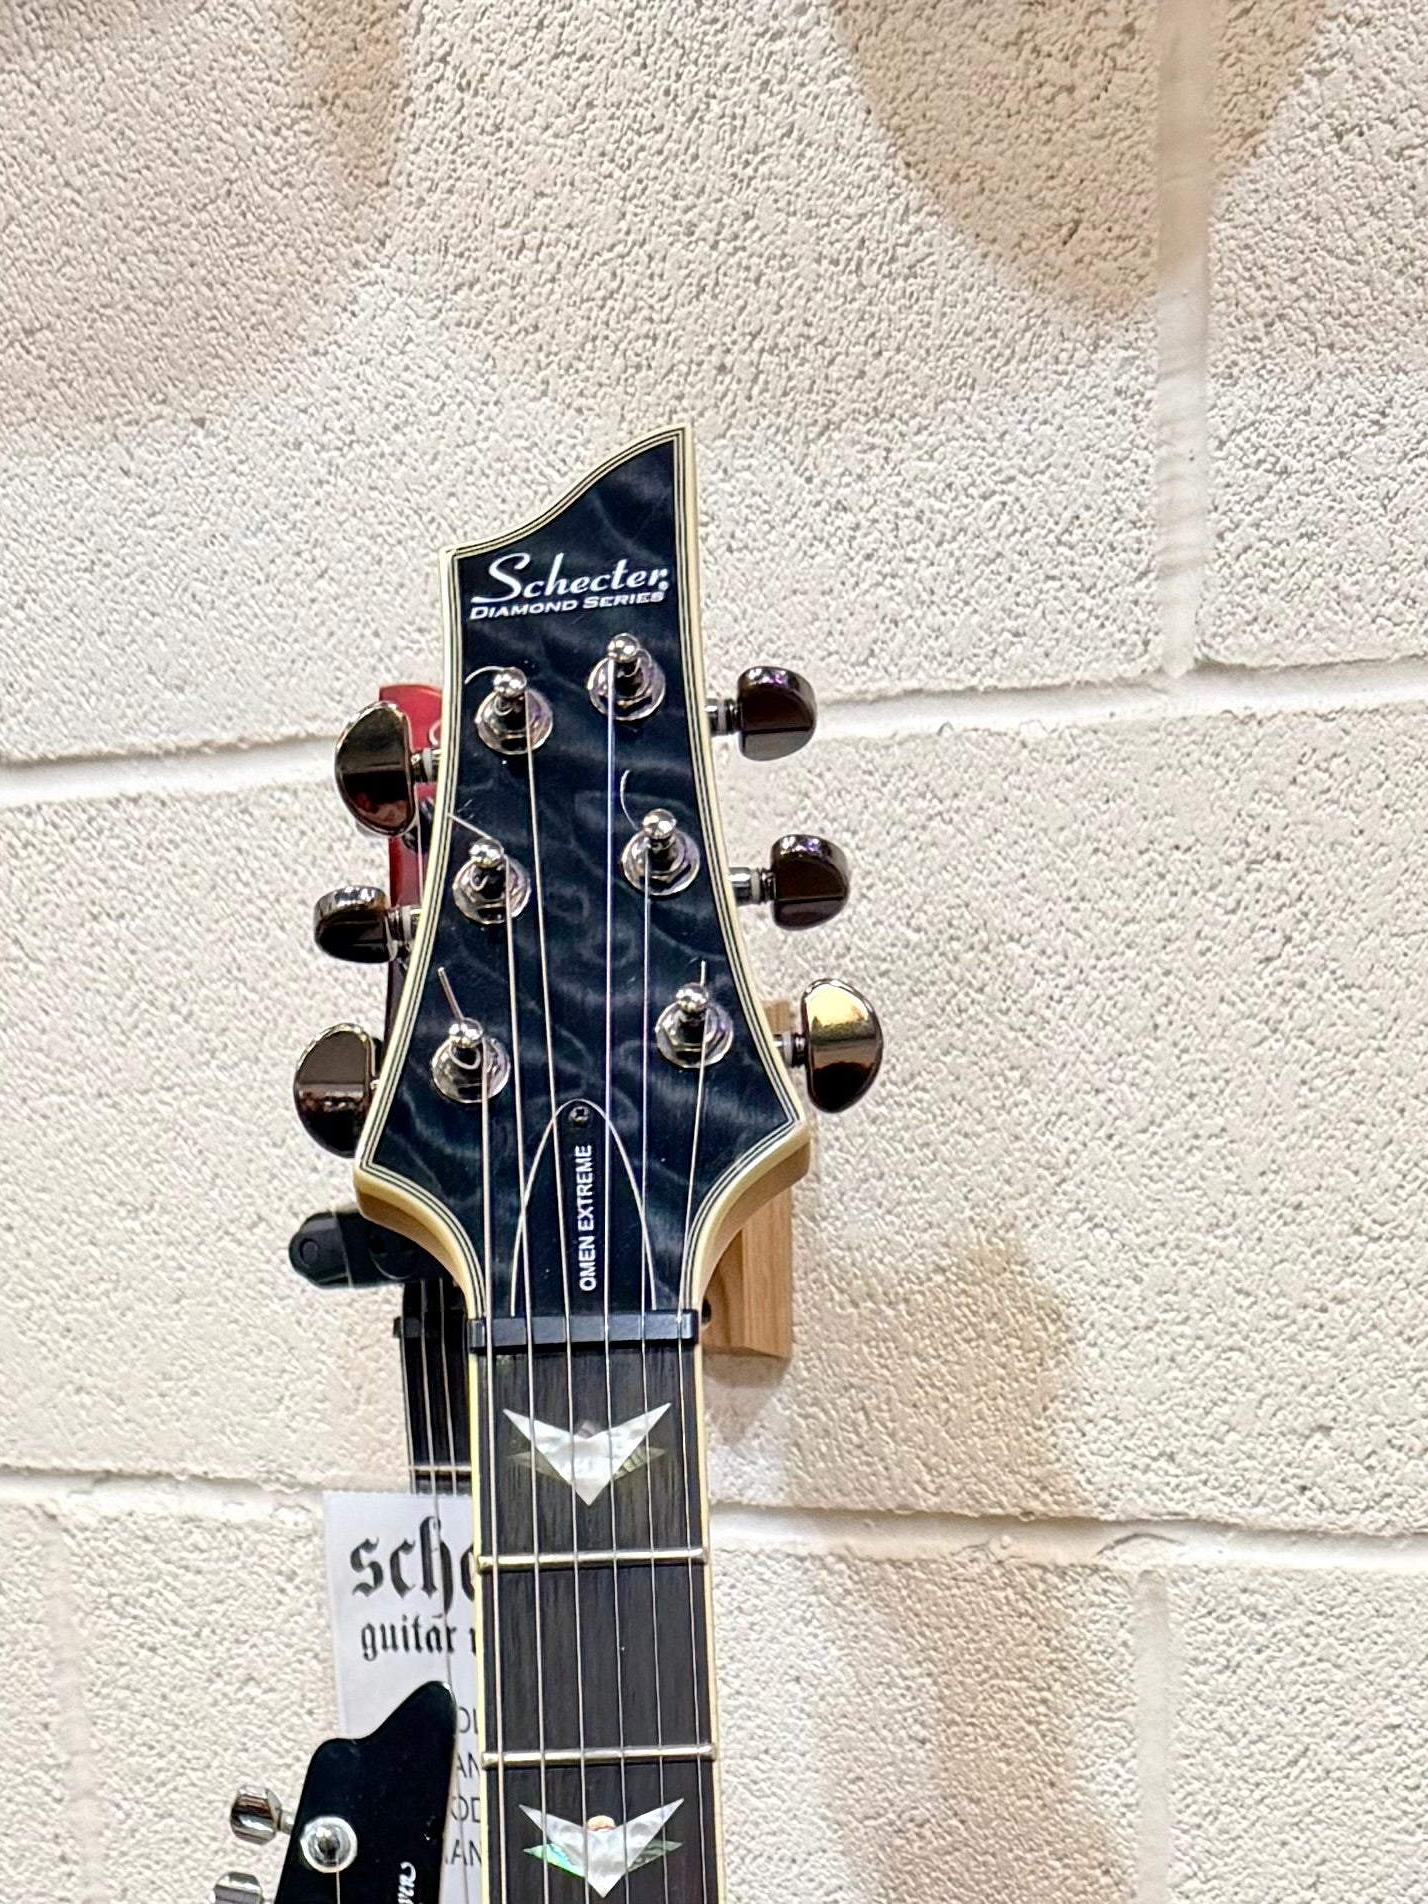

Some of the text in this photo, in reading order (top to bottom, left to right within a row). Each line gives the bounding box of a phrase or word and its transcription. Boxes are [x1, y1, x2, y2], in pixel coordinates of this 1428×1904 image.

[470, 552, 669, 604] Schecter
[469, 590, 666, 620] DIAMOND SERIES
[574, 1144, 597, 1292] OMEN EXTREME
[361, 1613, 457, 1662] guitar
